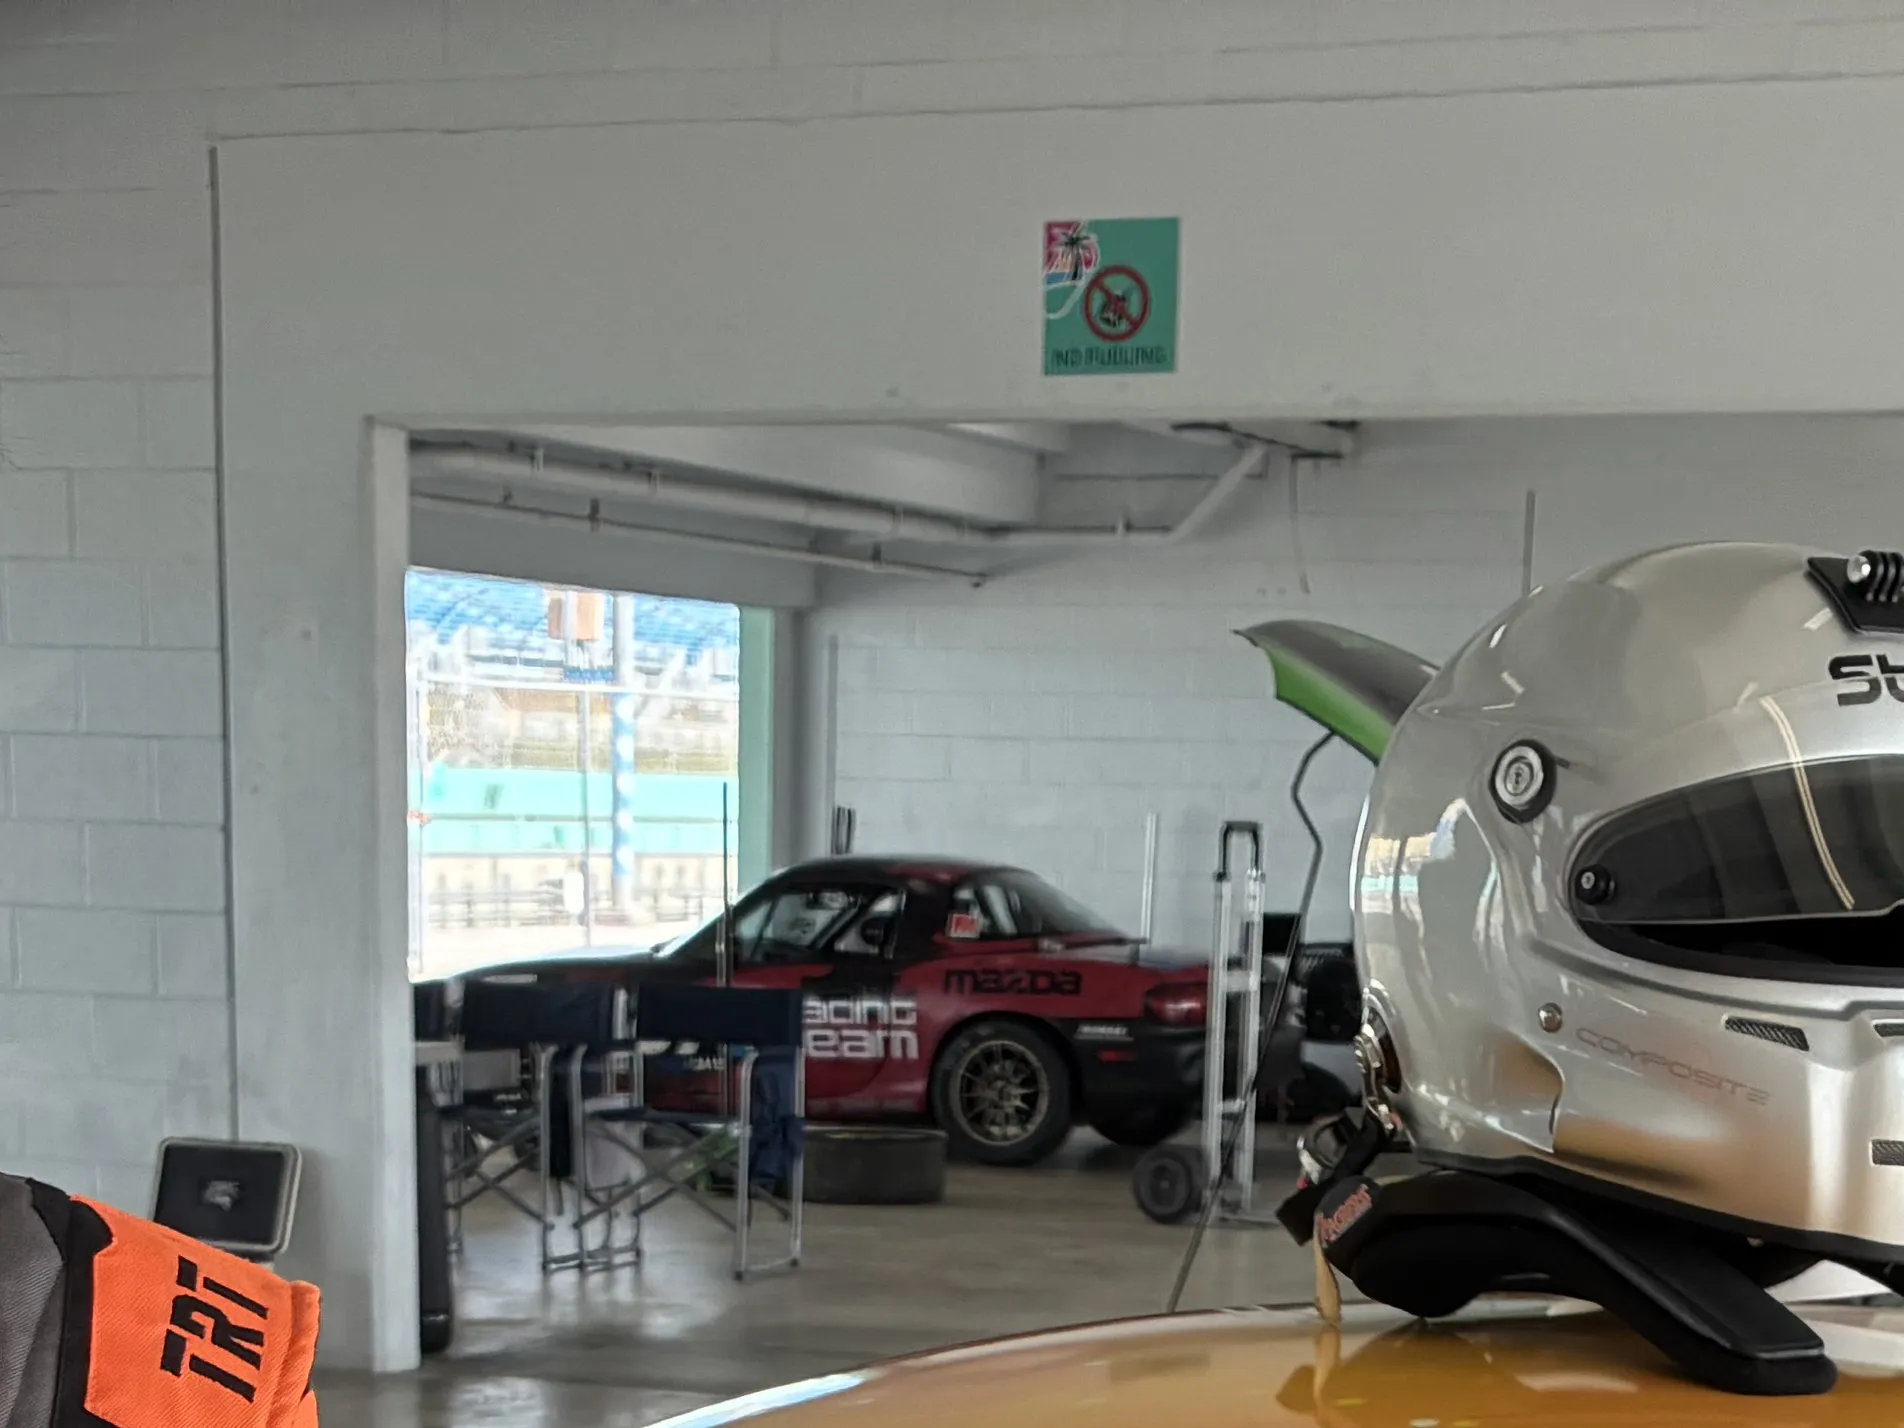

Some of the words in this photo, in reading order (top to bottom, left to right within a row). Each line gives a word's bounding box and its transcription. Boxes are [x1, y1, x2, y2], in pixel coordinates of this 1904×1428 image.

[803, 993, 917, 1025] acing
[805, 1029, 919, 1059] eam
[160, 1255, 270, 1404] TRT
